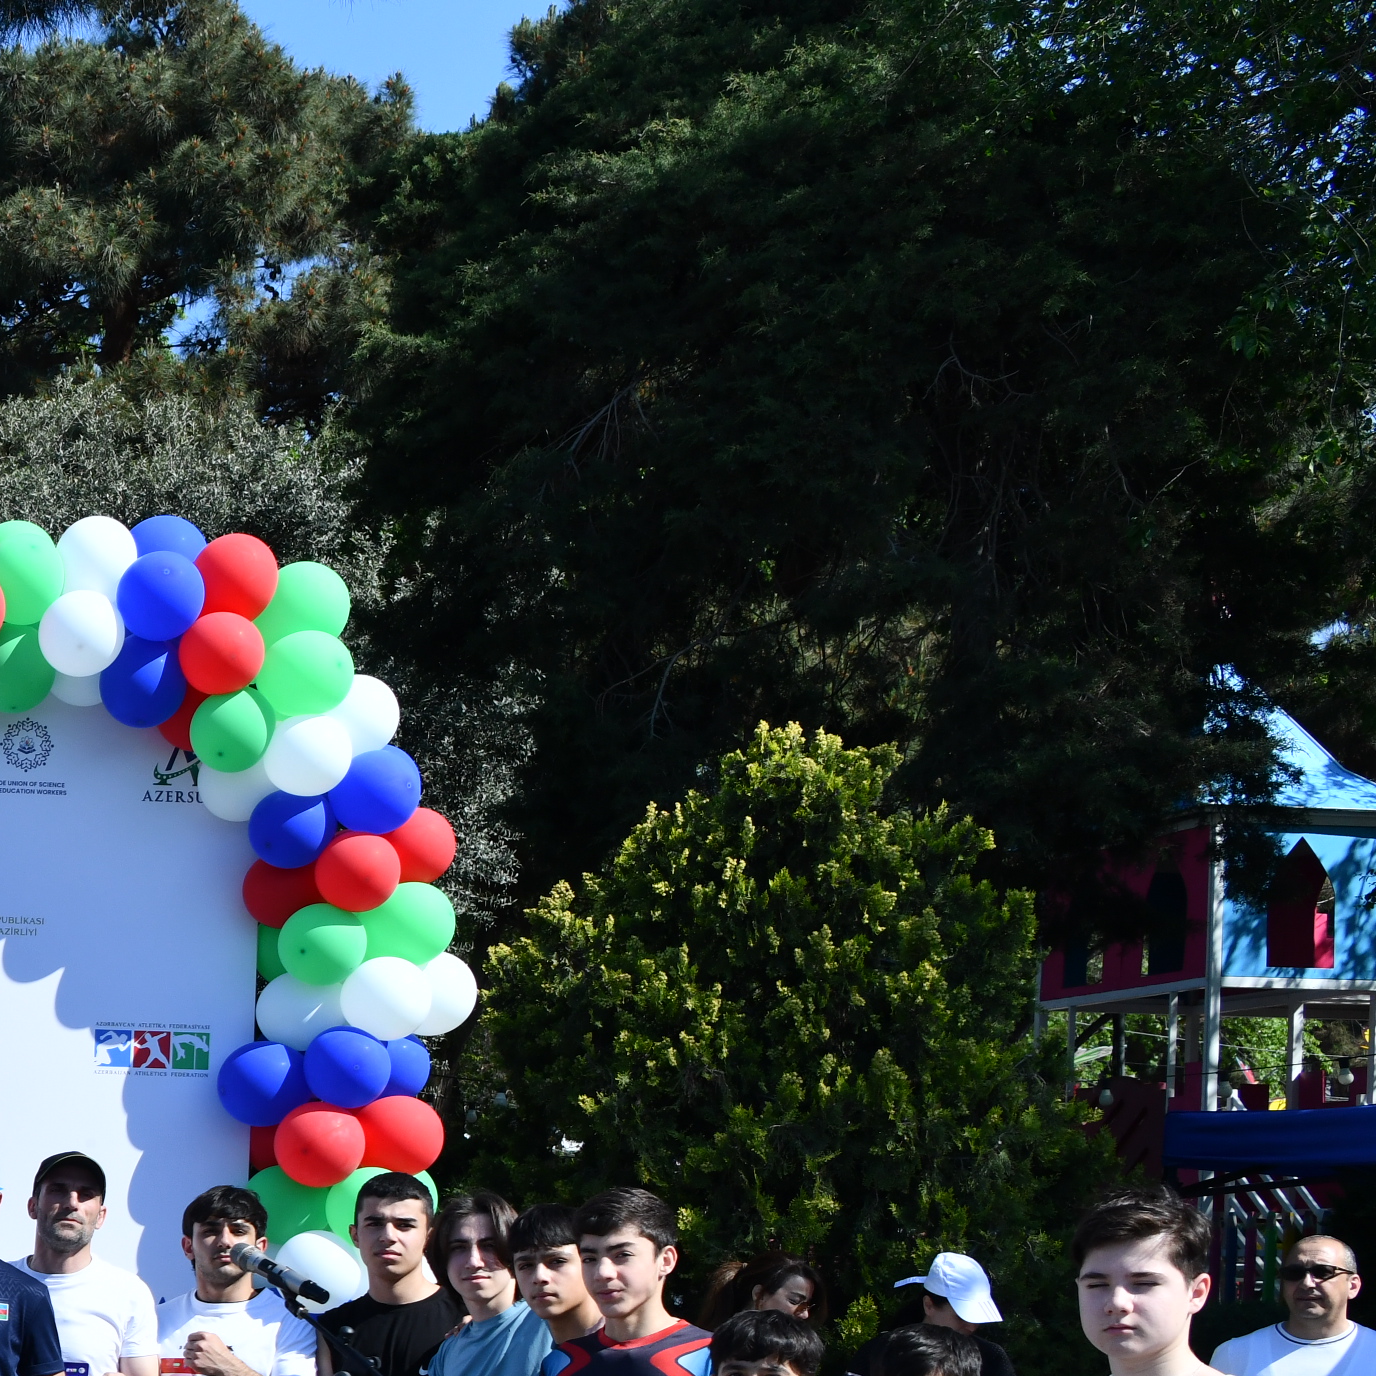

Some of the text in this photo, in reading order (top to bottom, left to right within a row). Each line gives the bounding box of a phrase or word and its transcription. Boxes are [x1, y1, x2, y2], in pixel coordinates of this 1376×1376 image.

[7, 780, 27, 788] UNION
[39, 781, 65, 789] SCIENCE
[0, 787, 35, 795] EDUCATION
[37, 788, 67, 796] WORKERS
[142, 789, 204, 804] AZERSU
